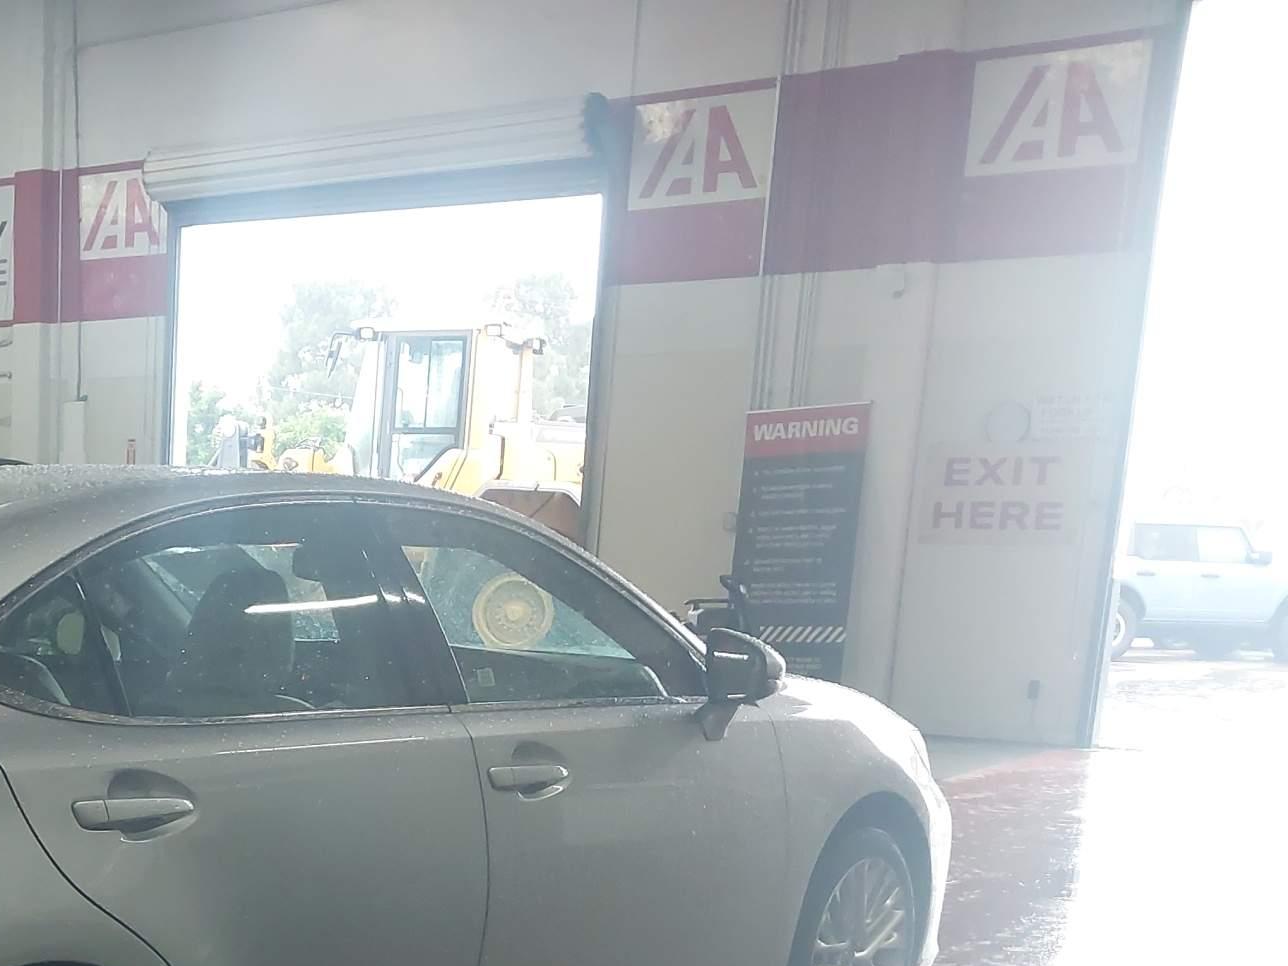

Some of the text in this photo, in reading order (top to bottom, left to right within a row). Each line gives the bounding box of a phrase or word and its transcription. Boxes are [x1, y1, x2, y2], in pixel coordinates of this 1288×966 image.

[754, 417, 859, 441] WARNING
[944, 456, 1062, 487] EXIT
[932, 501, 1064, 531] HERE
